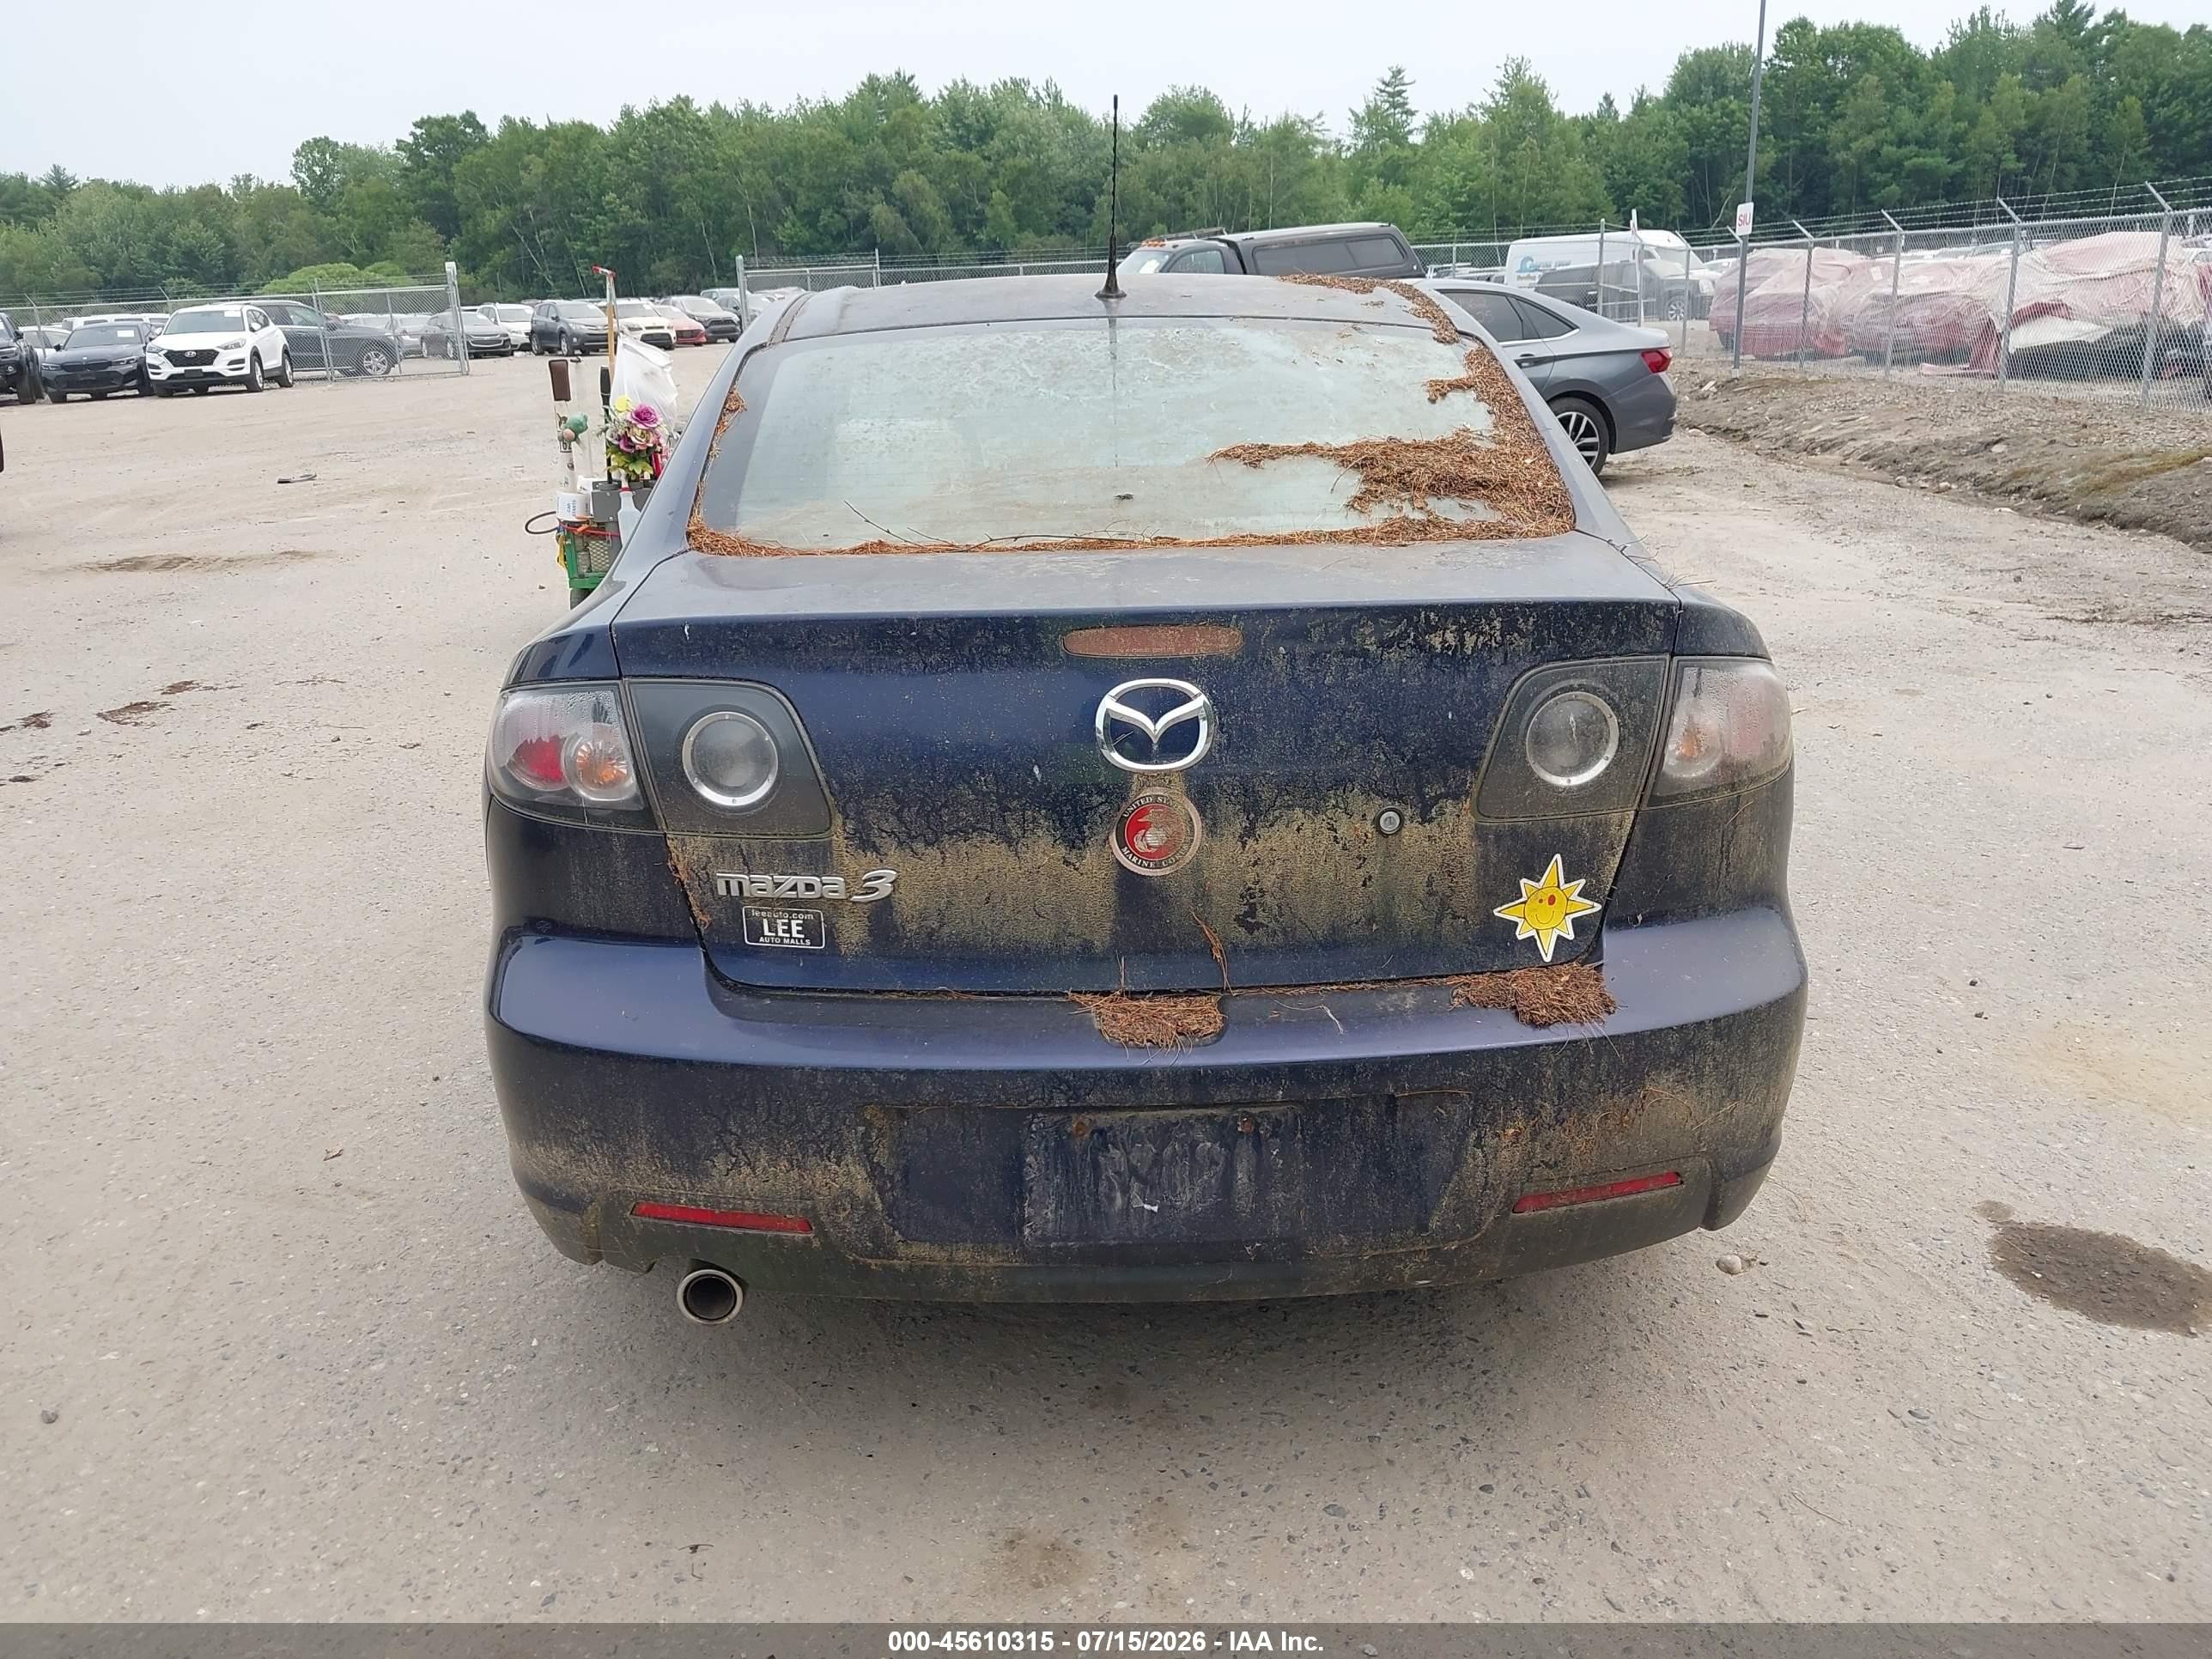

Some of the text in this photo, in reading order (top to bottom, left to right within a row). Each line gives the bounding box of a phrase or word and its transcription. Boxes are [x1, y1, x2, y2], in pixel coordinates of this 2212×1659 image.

[1738, 213, 1752, 227] SIU
[1121, 796, 1153, 818] UNITED
[1121, 846, 1156, 868] MARINE
[763, 918, 805, 939] LEE
[759, 936, 811, 946] AUTO MALLS
